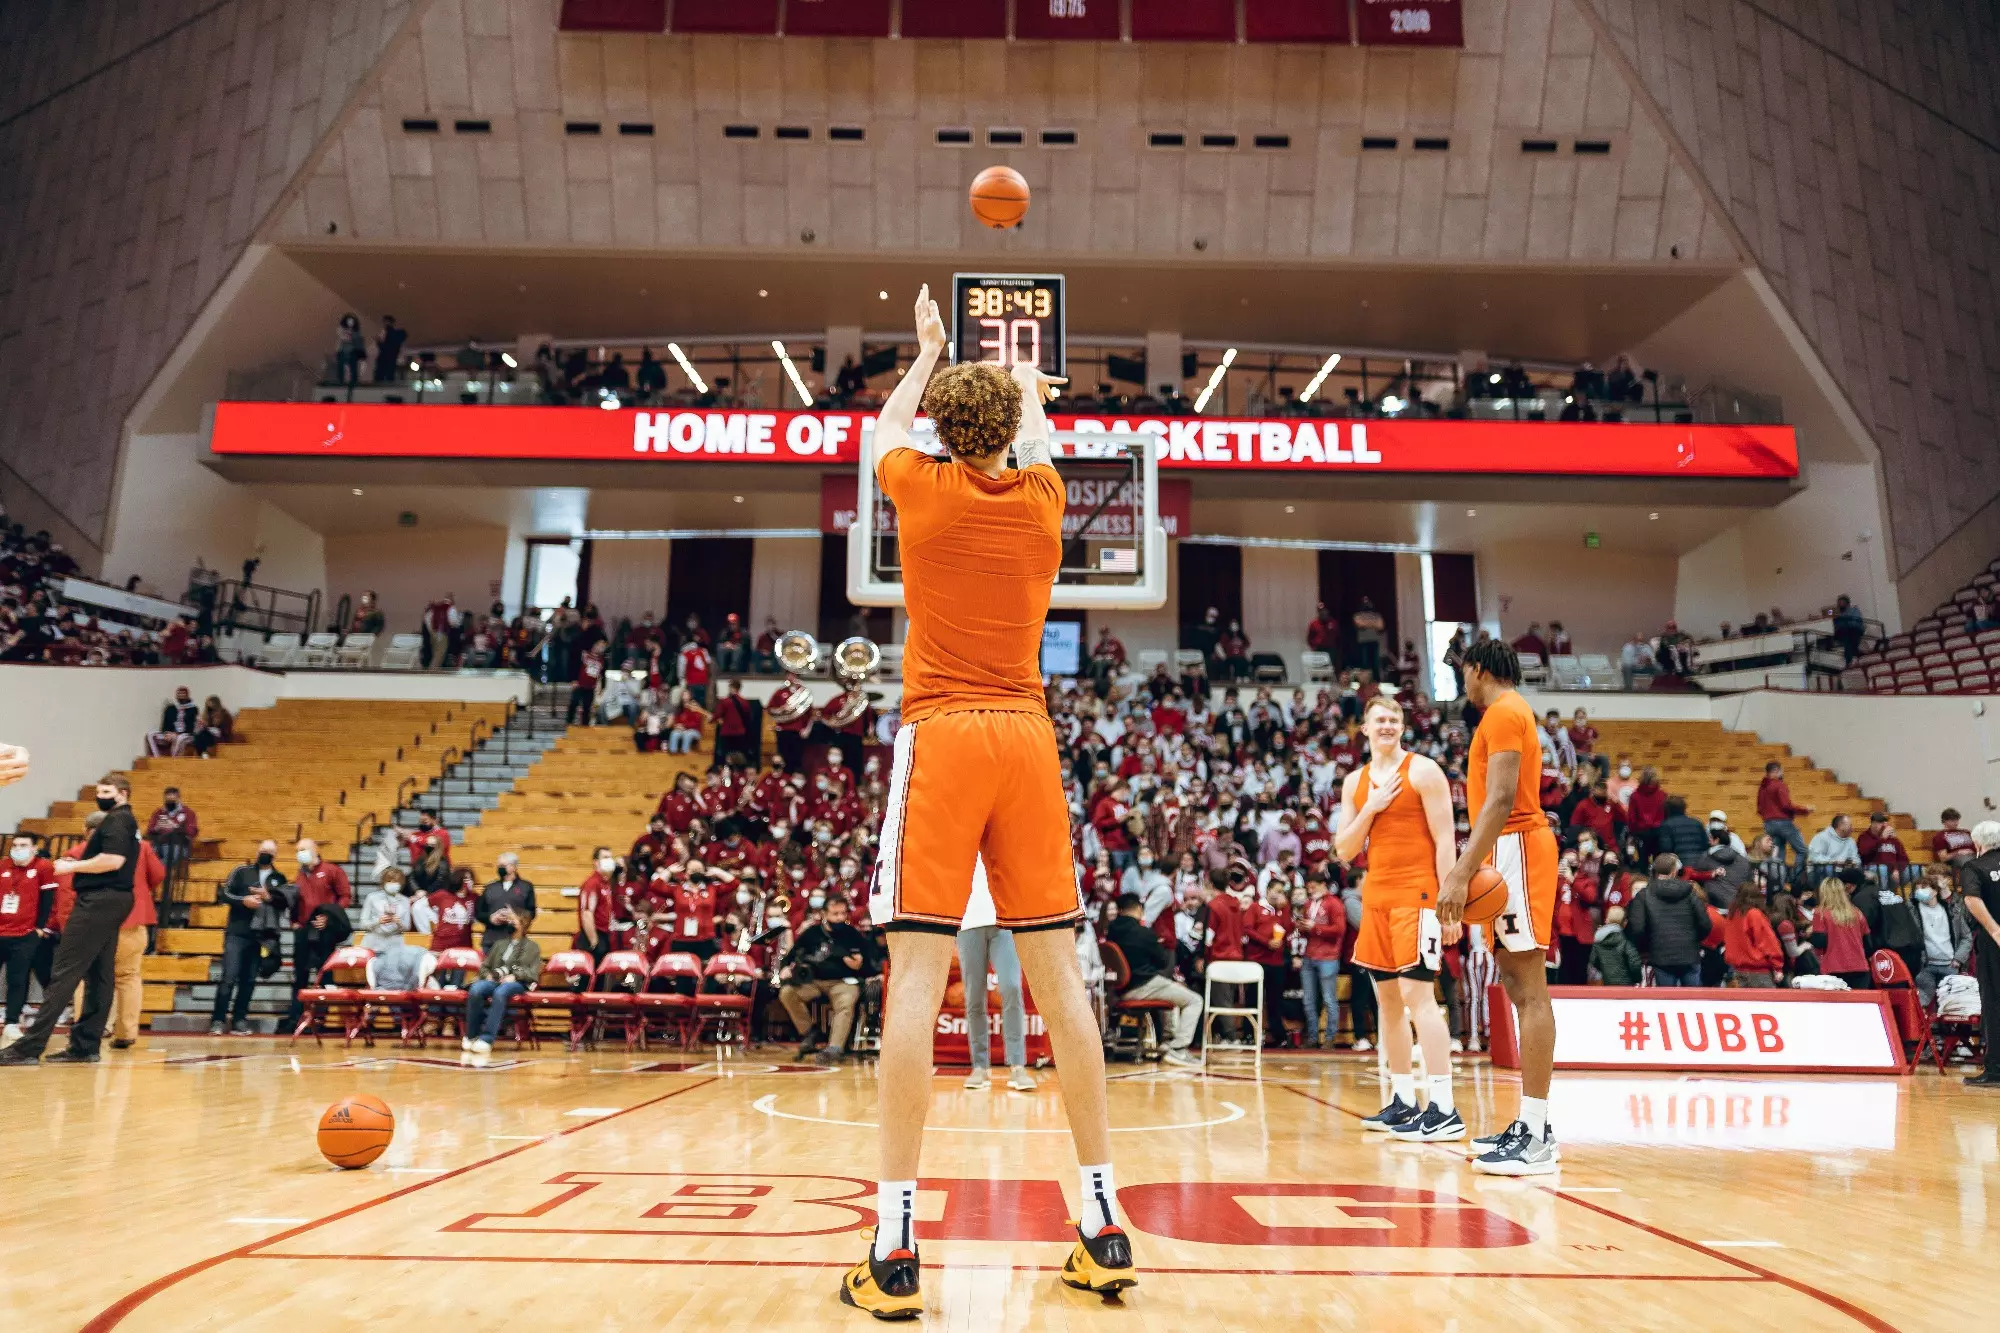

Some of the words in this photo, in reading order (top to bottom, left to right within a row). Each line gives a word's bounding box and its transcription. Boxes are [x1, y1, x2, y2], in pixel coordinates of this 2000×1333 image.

[968, 287, 1052, 318] 38:43
[979, 318, 1040, 368] 30
[633, 412, 776, 454] HOME
[786, 415, 852, 456] OF
[1074, 419, 1382, 464] BASKETBALL
[1502, 913, 1520, 935] I
[1427, 937, 1437, 955] I
[1618, 1011, 1785, 1053] #IUBB
